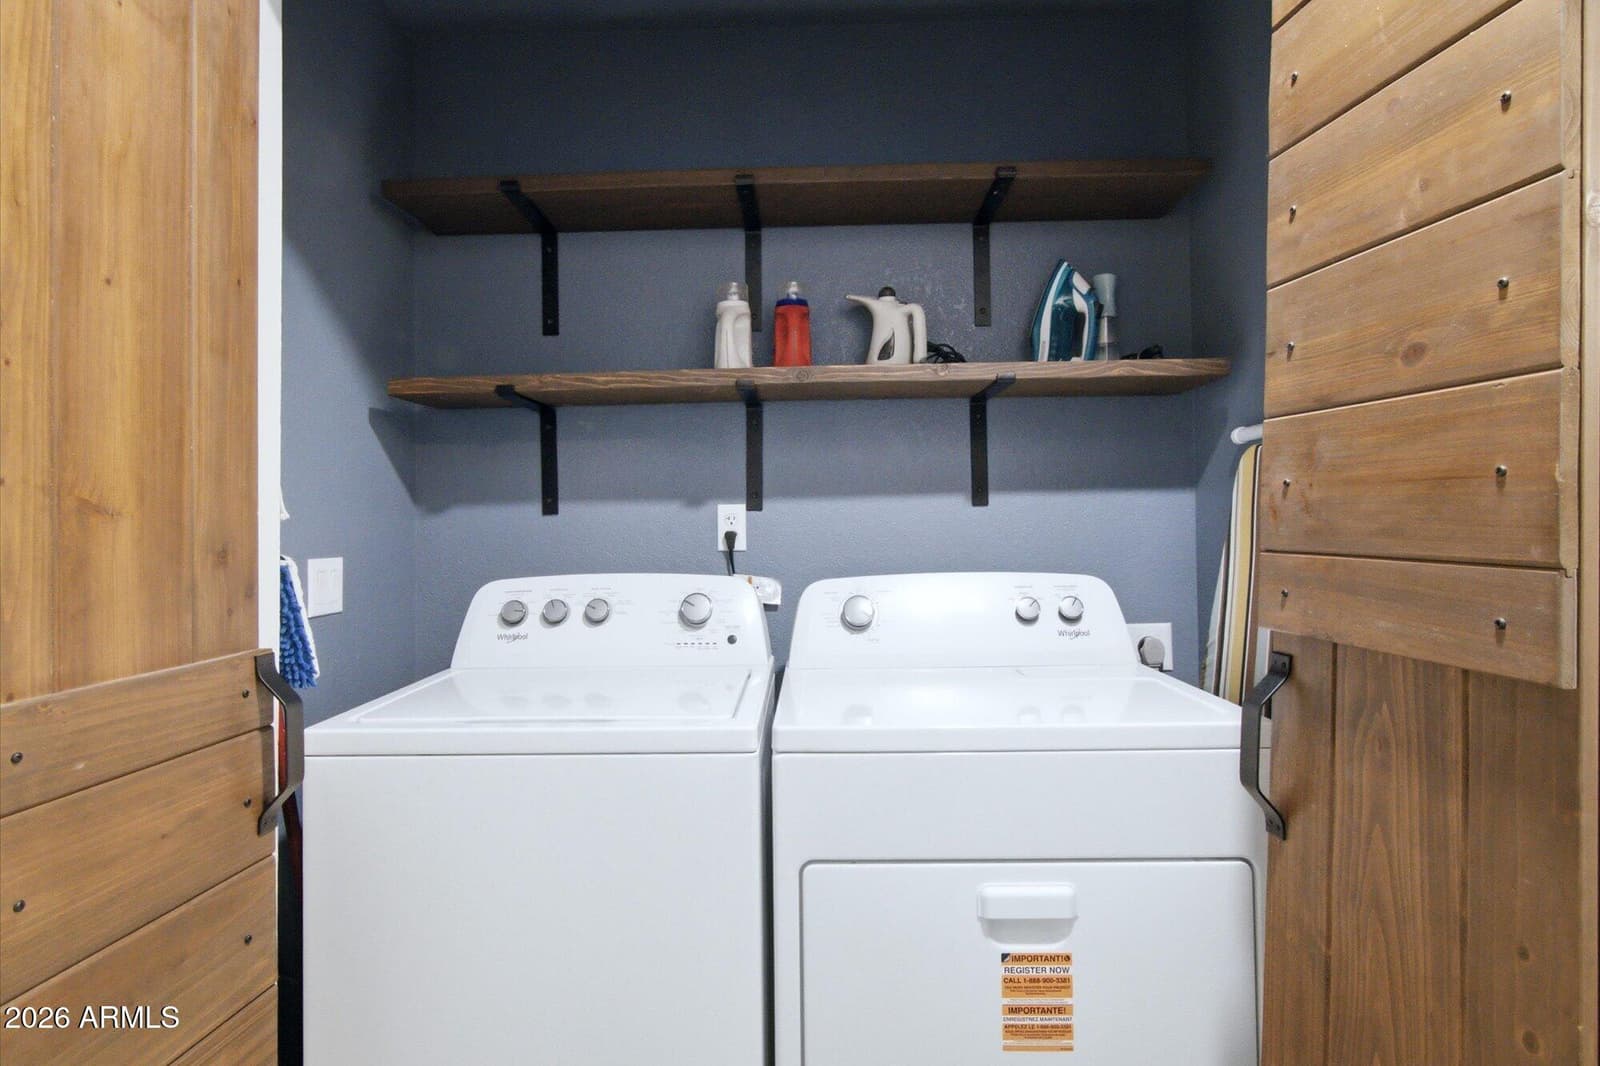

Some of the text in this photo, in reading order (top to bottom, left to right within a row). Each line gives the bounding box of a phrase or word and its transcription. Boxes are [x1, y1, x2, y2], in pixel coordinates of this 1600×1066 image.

[496, 631, 529, 644] Whirlpool
[1057, 629, 1090, 640] Whirlpool
[1011, 955, 1064, 963] IMPORTANT!
[1003, 966, 1070, 974] REGISTER NOW
[1008, 1006, 1066, 1014] IMPORTANTE!
